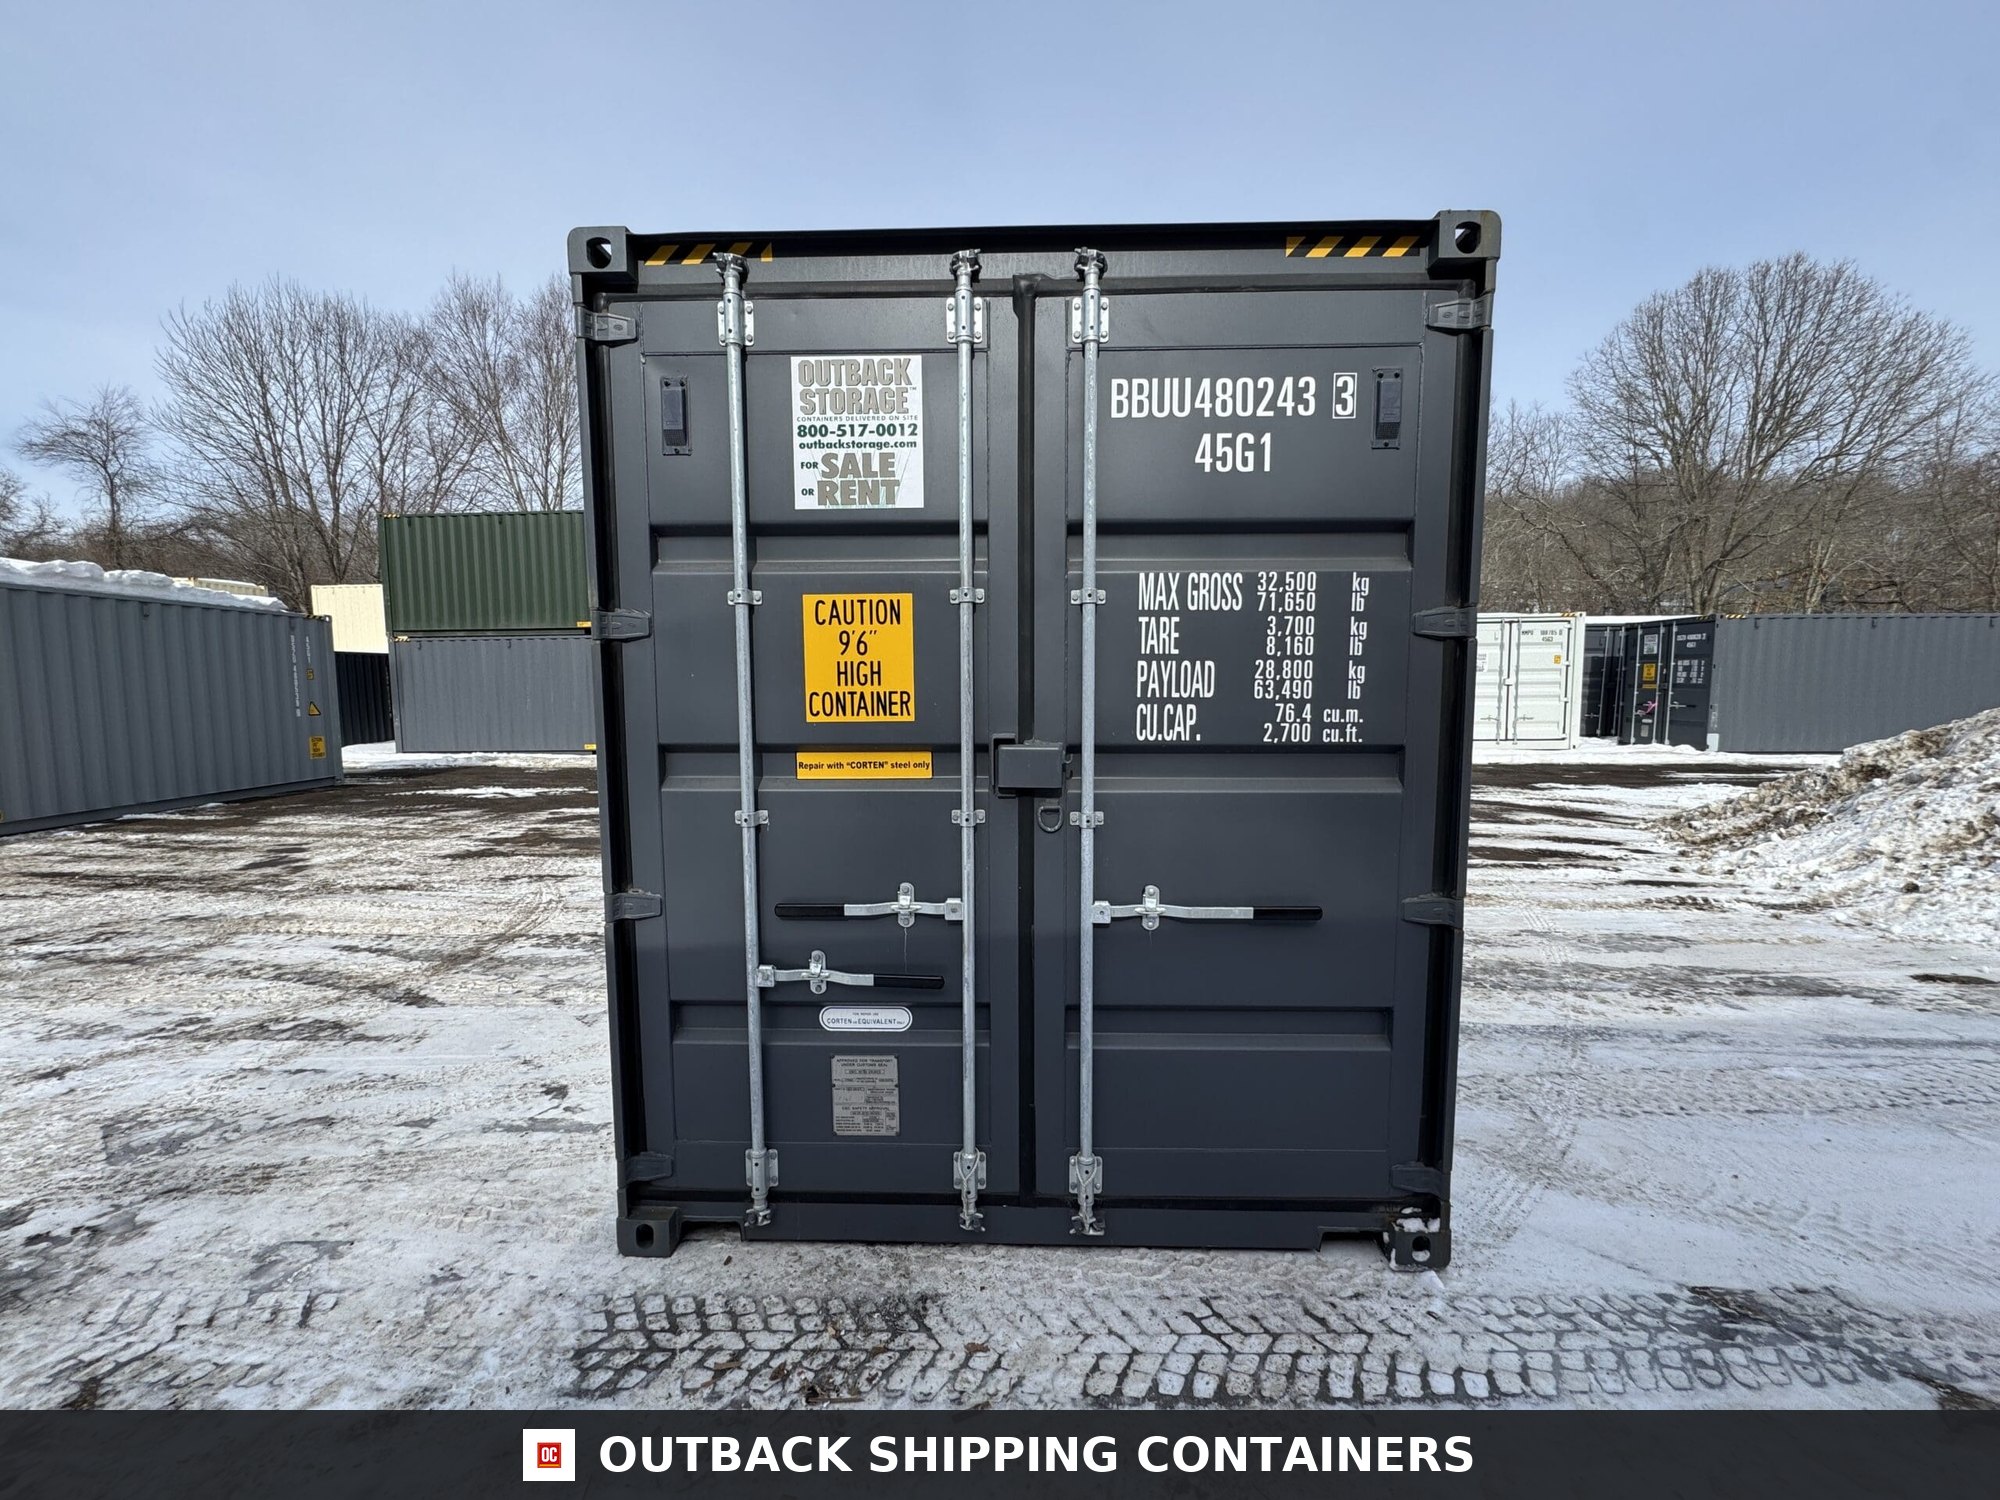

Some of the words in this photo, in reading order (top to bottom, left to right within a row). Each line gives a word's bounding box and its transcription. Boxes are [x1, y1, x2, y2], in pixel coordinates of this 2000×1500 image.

[798, 358, 912, 387] OUTBACK
[800, 387, 909, 415] STORAGE
[1110, 376, 1316, 418] BBUU480243
[1335, 376, 1354, 416] 3
[797, 423, 918, 438] 800-517-0012
[799, 439, 917, 450] outbackstorage.com
[1194, 432, 1271, 472] 45G1
[800, 462, 818, 470] FOR
[821, 452, 896, 478] SALE
[802, 488, 814, 496] OR
[817, 480, 900, 506] RENT
[1138, 572, 1180, 611] MAX
[1187, 572, 1243, 611] GROSS
[1257, 572, 1316, 592] 32,500
[1352, 572, 1370, 596] kg
[1257, 592, 1316, 613] 71,650
[1351, 594, 1364, 612] lb
[814, 599, 900, 625] CAUTION
[1138, 616, 1180, 654] TARE
[1266, 616, 1315, 637] 3,700
[1350, 616, 1368, 640] kg
[1266, 636, 1314, 657] 8,160
[1349, 637, 1362, 656] lb
[836, 660, 882, 686] HIGH
[1136, 660, 1215, 698] PAYLOAD
[1254, 660, 1313, 681] 28,800
[1348, 660, 1366, 684] kg
[808, 690, 911, 716] CONTAINER
[1254, 680, 1312, 701] 63,490
[1348, 680, 1361, 700] lb
[1136, 704, 1200, 741] CU.CAP.
[1275, 703, 1312, 723] 76.4
[1323, 708, 1364, 722] cu.m.
[1263, 723, 1311, 744] 2,700
[1322, 724, 1362, 742] cu.ft.
[798, 762, 824, 770] Repair
[912, 760, 930, 770] only
